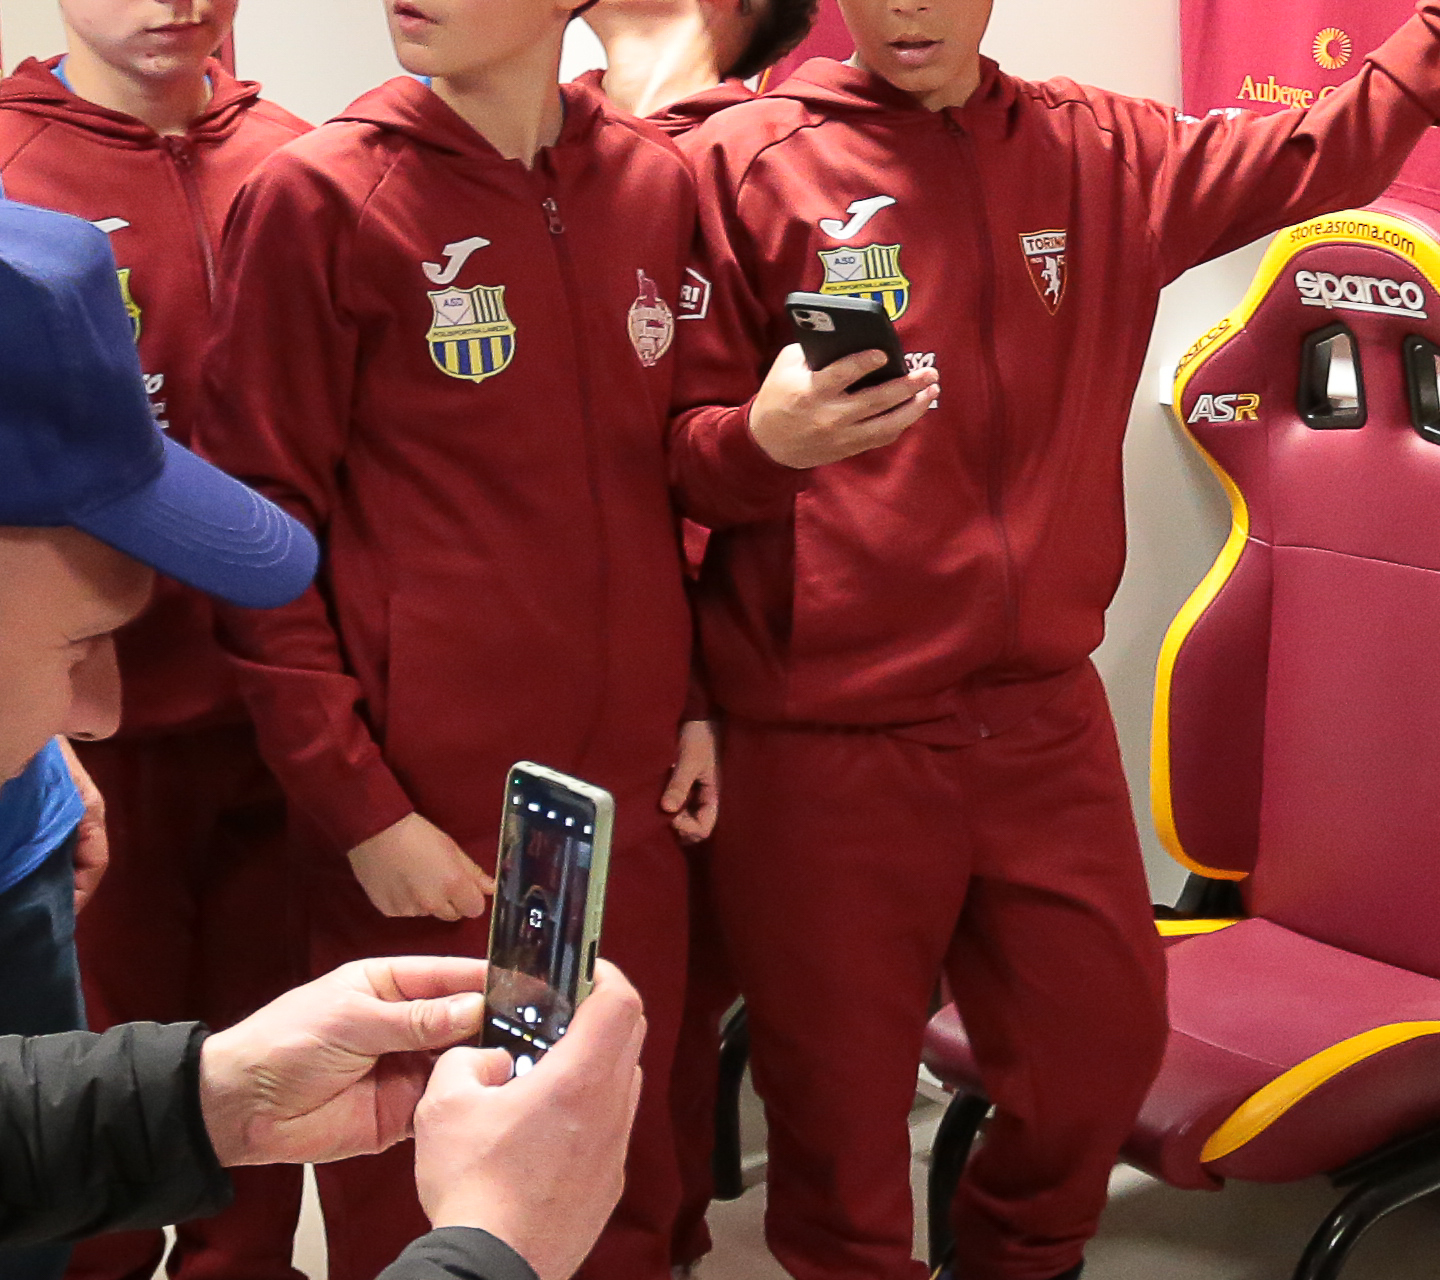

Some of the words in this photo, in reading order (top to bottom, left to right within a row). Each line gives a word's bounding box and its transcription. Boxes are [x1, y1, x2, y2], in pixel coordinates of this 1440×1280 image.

[1236, 74, 1314, 109] Auberge
[1289, 219, 1416, 256] store.asroma.com
[1295, 270, 1426, 310] sparco
[1187, 393, 1261, 424] ASR
